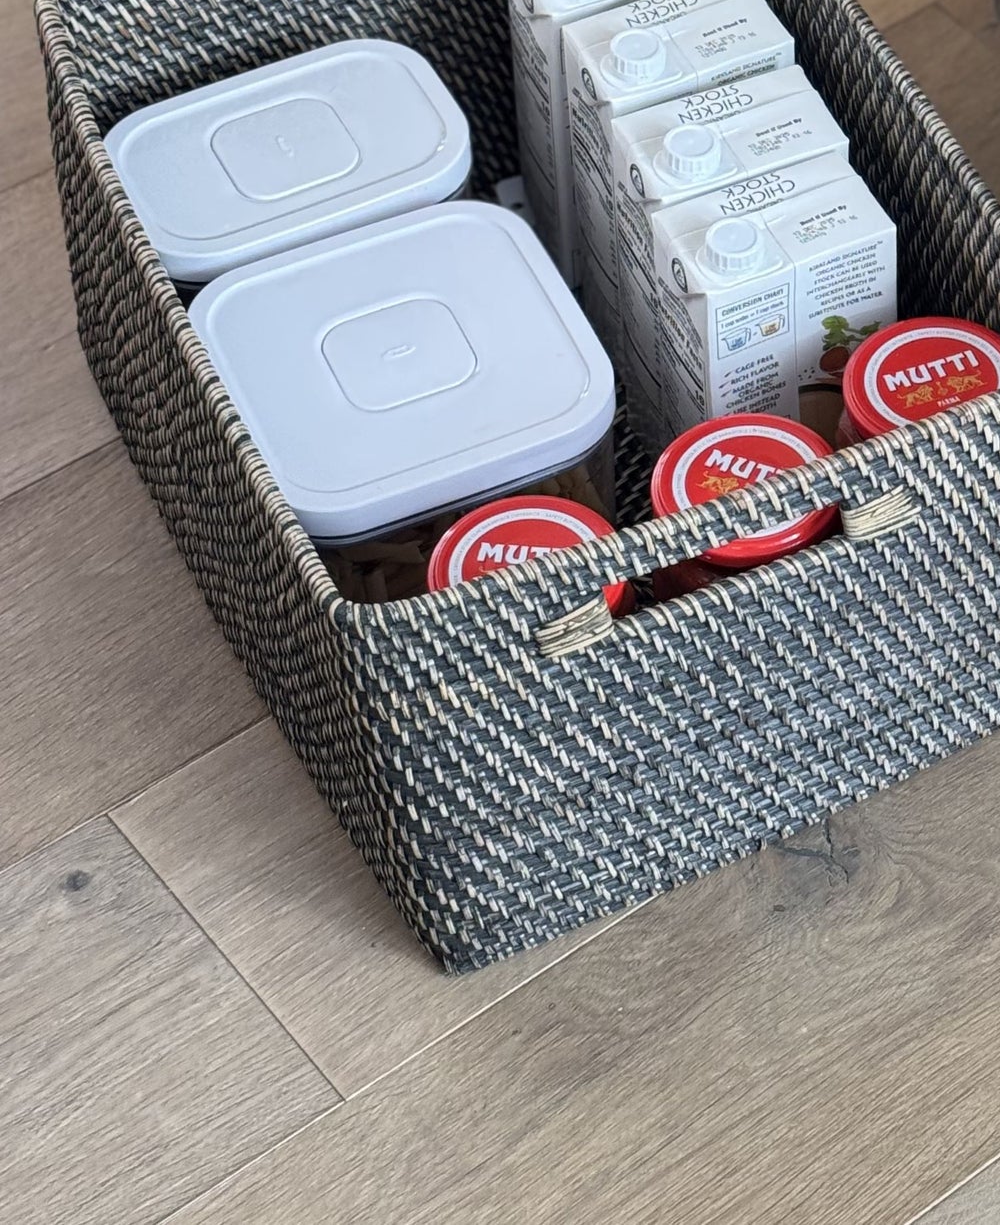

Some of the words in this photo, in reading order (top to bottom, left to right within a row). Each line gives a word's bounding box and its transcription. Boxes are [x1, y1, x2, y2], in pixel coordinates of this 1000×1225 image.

[682, 85, 739, 108] STOCK
[678, 94, 753, 124] CHICKEN
[720, 179, 795, 215] CHICKEN
[722, 173, 780, 198] STOCK
[722, 297, 762, 316] CONVERSION
[731, 374, 749, 384] RICH
[751, 361, 779, 377] FLAVOR
[735, 362, 754, 373] CAGE
[757, 354, 773, 365] FREE
[882, 350, 980, 391] MUTTI
[733, 381, 754, 393] MADE
[756, 372, 778, 384] FROM
[738, 380, 773, 397] ORGANIC
[726, 392, 759, 408] CHICKEN
[762, 381, 786, 394] BONES
[749, 393, 780, 409] INSTEAD
[704, 449, 783, 482] MUT
[477, 542, 563, 565] MUT
